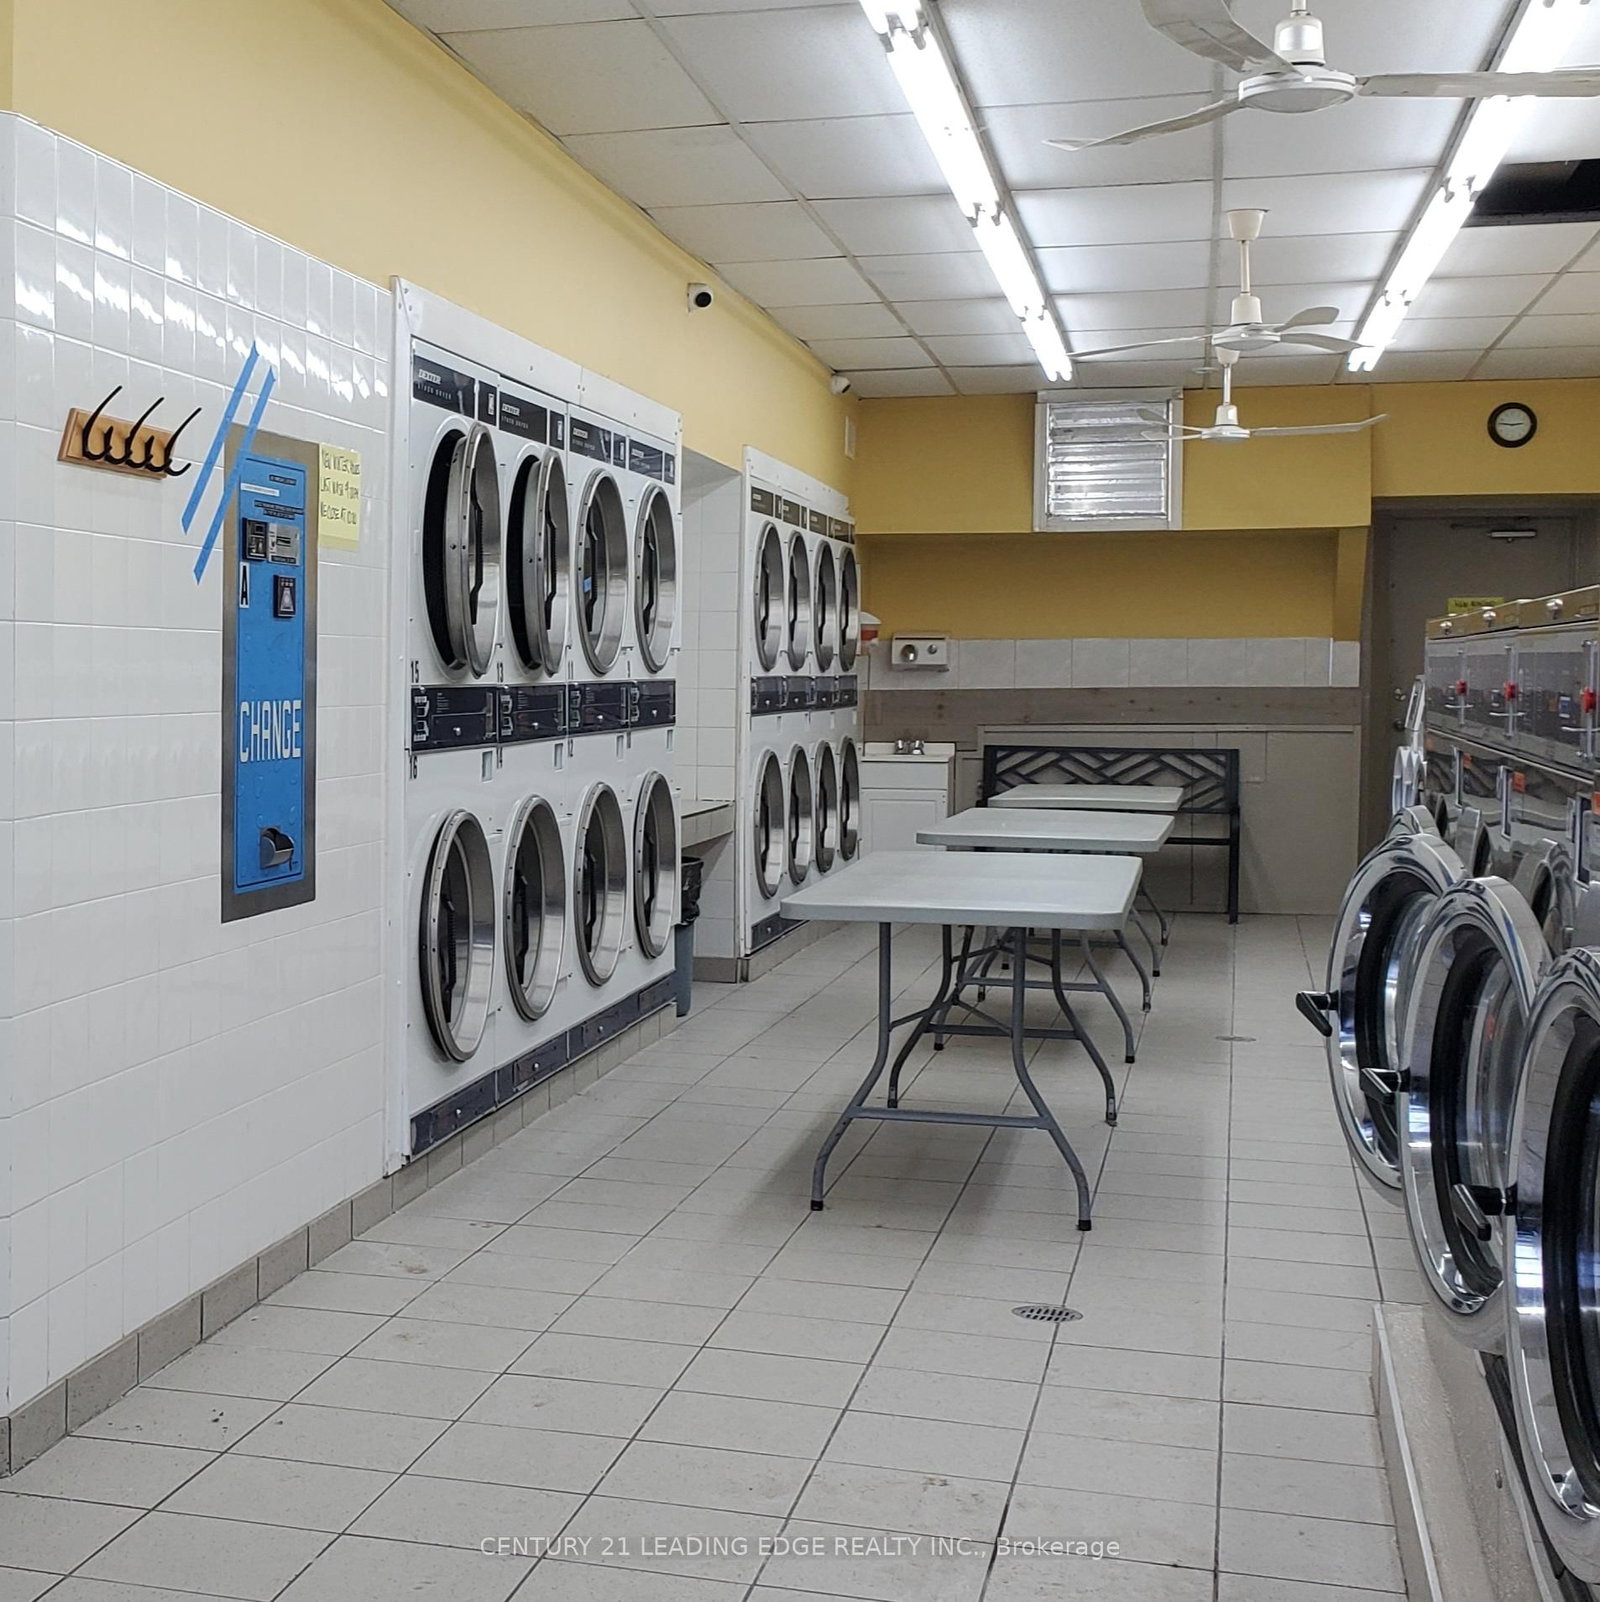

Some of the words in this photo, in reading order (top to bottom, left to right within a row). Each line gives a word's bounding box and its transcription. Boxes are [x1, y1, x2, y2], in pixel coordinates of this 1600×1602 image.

[240, 565, 248, 606] A
[411, 660, 419, 683] 15
[240, 700, 301, 762] CHANGE
[409, 755, 418, 780] 16
